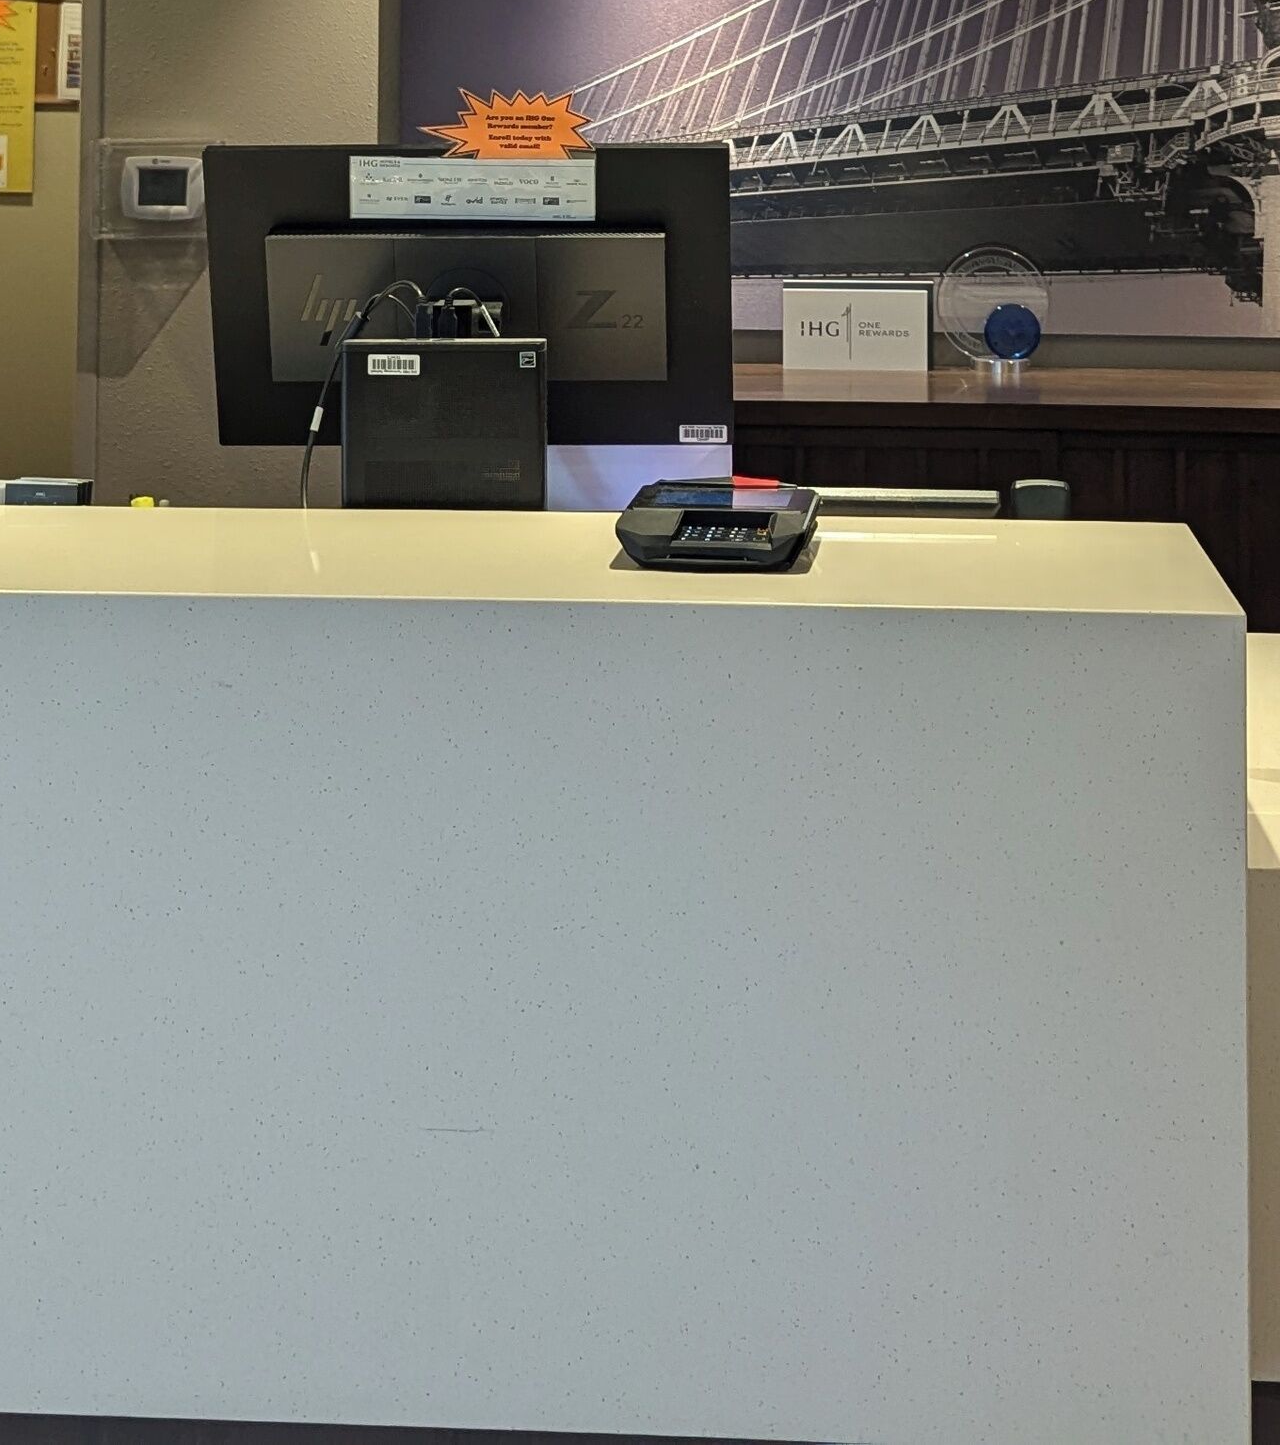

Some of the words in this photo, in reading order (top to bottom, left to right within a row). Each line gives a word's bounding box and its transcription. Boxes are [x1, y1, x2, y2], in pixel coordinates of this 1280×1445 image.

[565, 290, 618, 329] Z
[622, 314, 644, 329] 22
[800, 321, 840, 337] IHG
